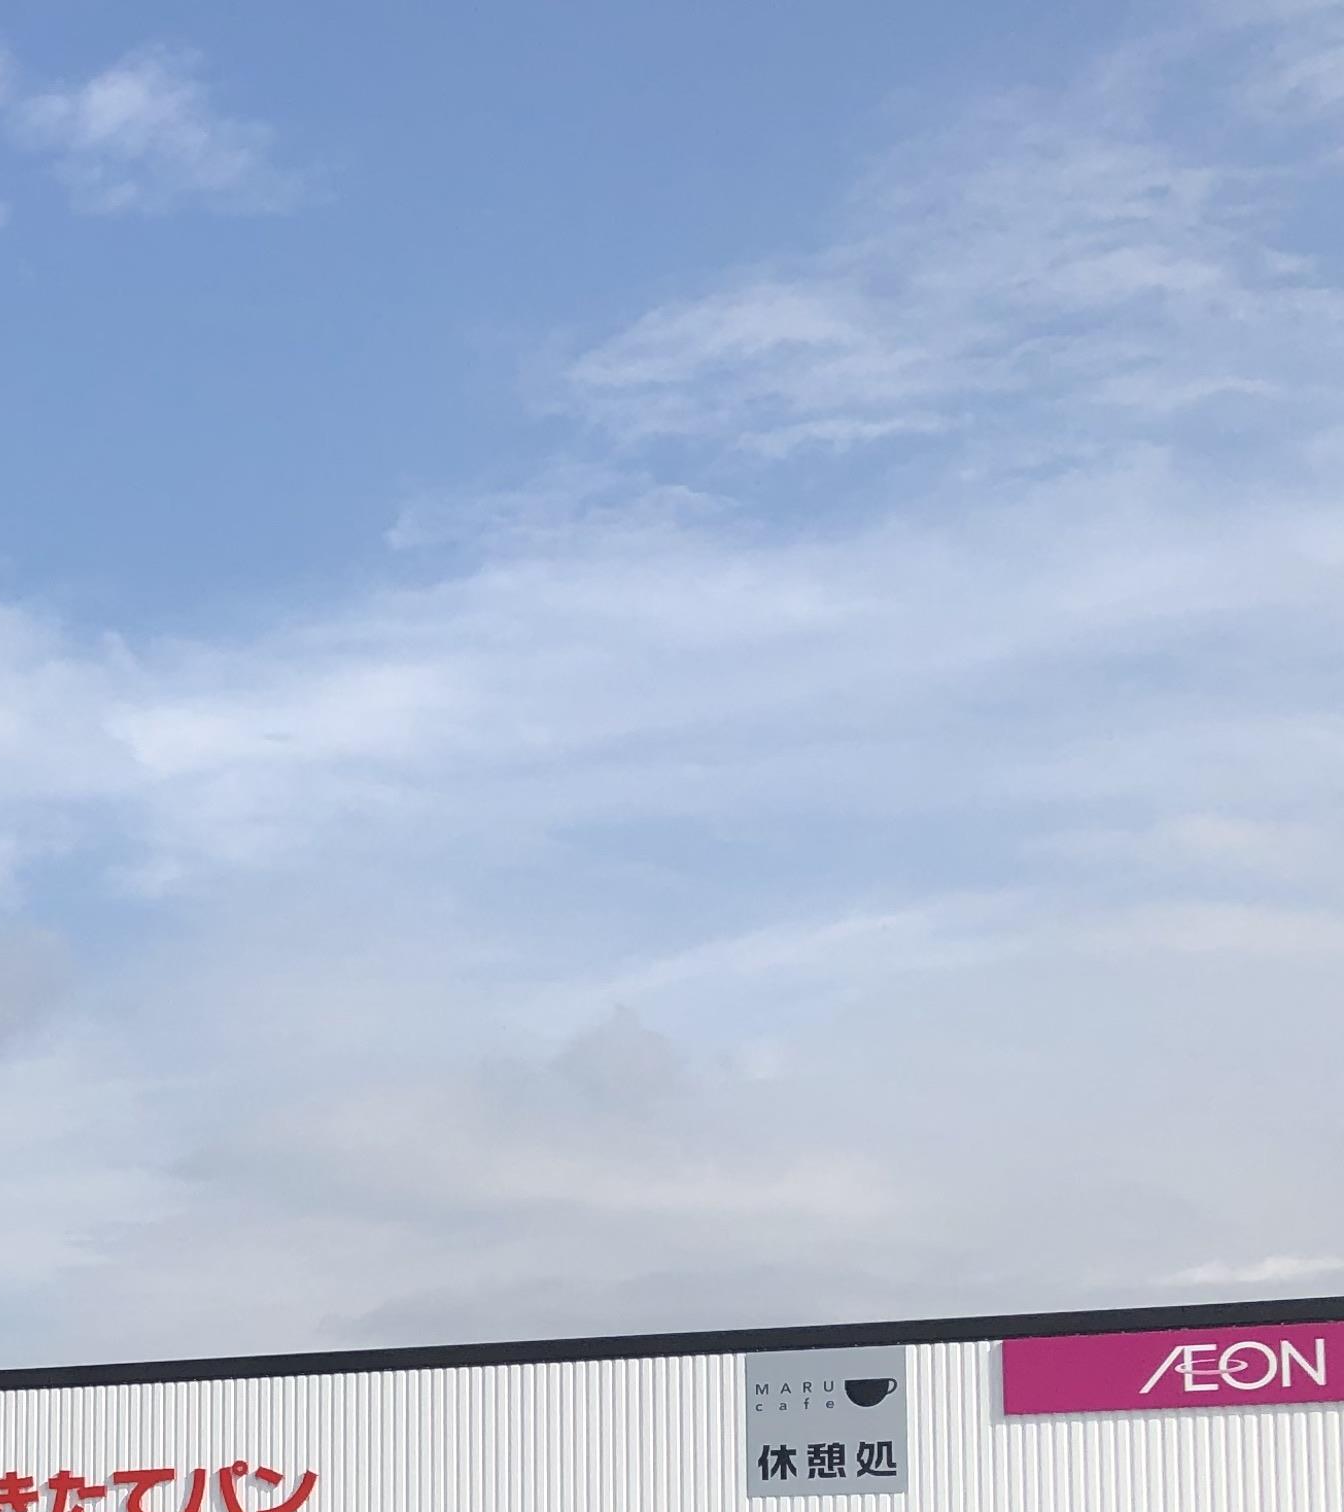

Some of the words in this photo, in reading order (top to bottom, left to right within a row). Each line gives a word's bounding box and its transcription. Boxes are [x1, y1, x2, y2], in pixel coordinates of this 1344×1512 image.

[755, 1380, 835, 1395] MARU
[755, 1397, 835, 1412] cafe
[757, 1441, 897, 1481] 休憩処
